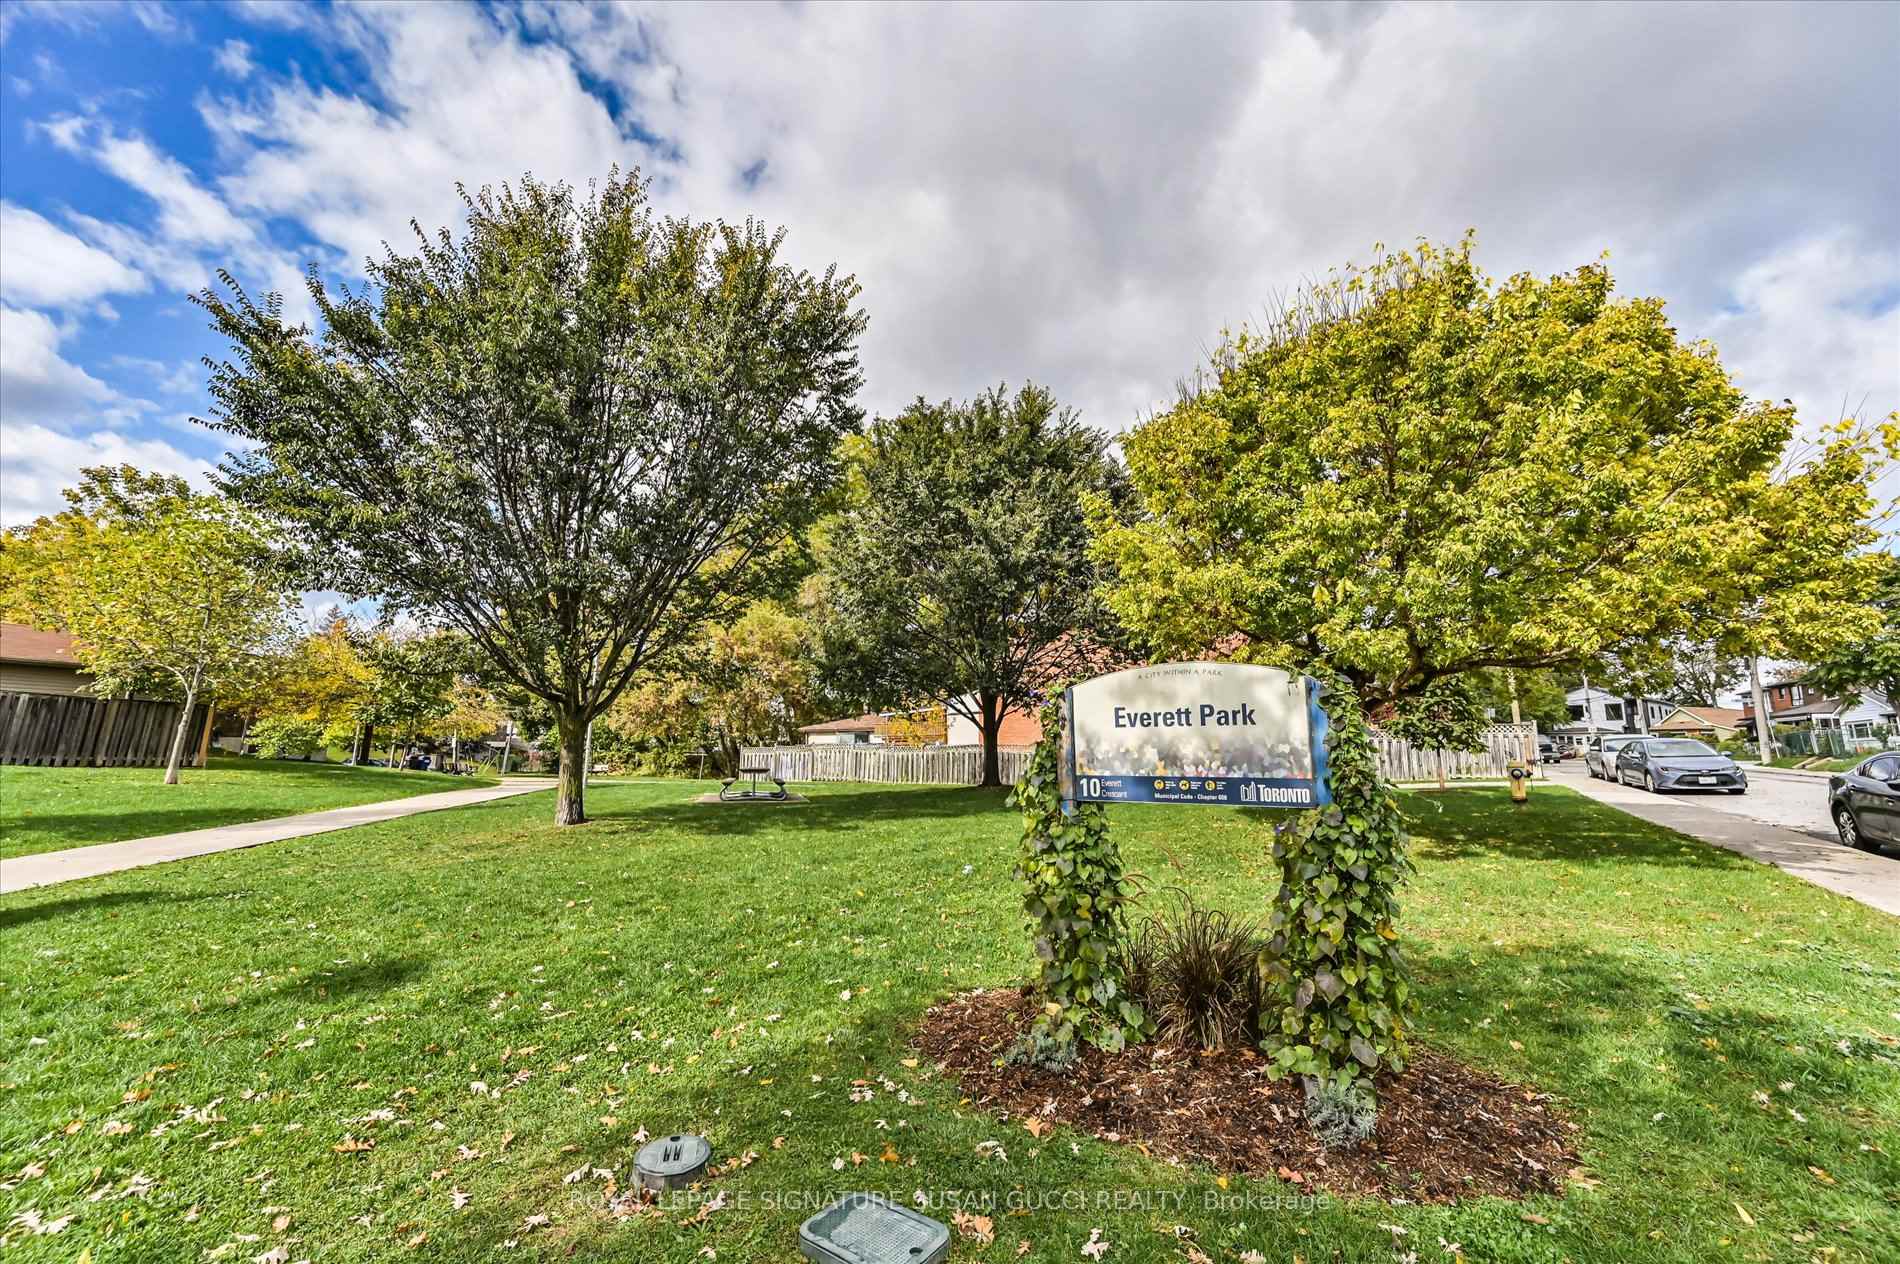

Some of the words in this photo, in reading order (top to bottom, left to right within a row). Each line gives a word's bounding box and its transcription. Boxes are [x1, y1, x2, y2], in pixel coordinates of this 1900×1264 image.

[1114, 706, 1192, 728] Everett
[1199, 703, 1256, 726] Park
[1080, 777, 1100, 797] 10
[1257, 784, 1310, 803] TORONTO
